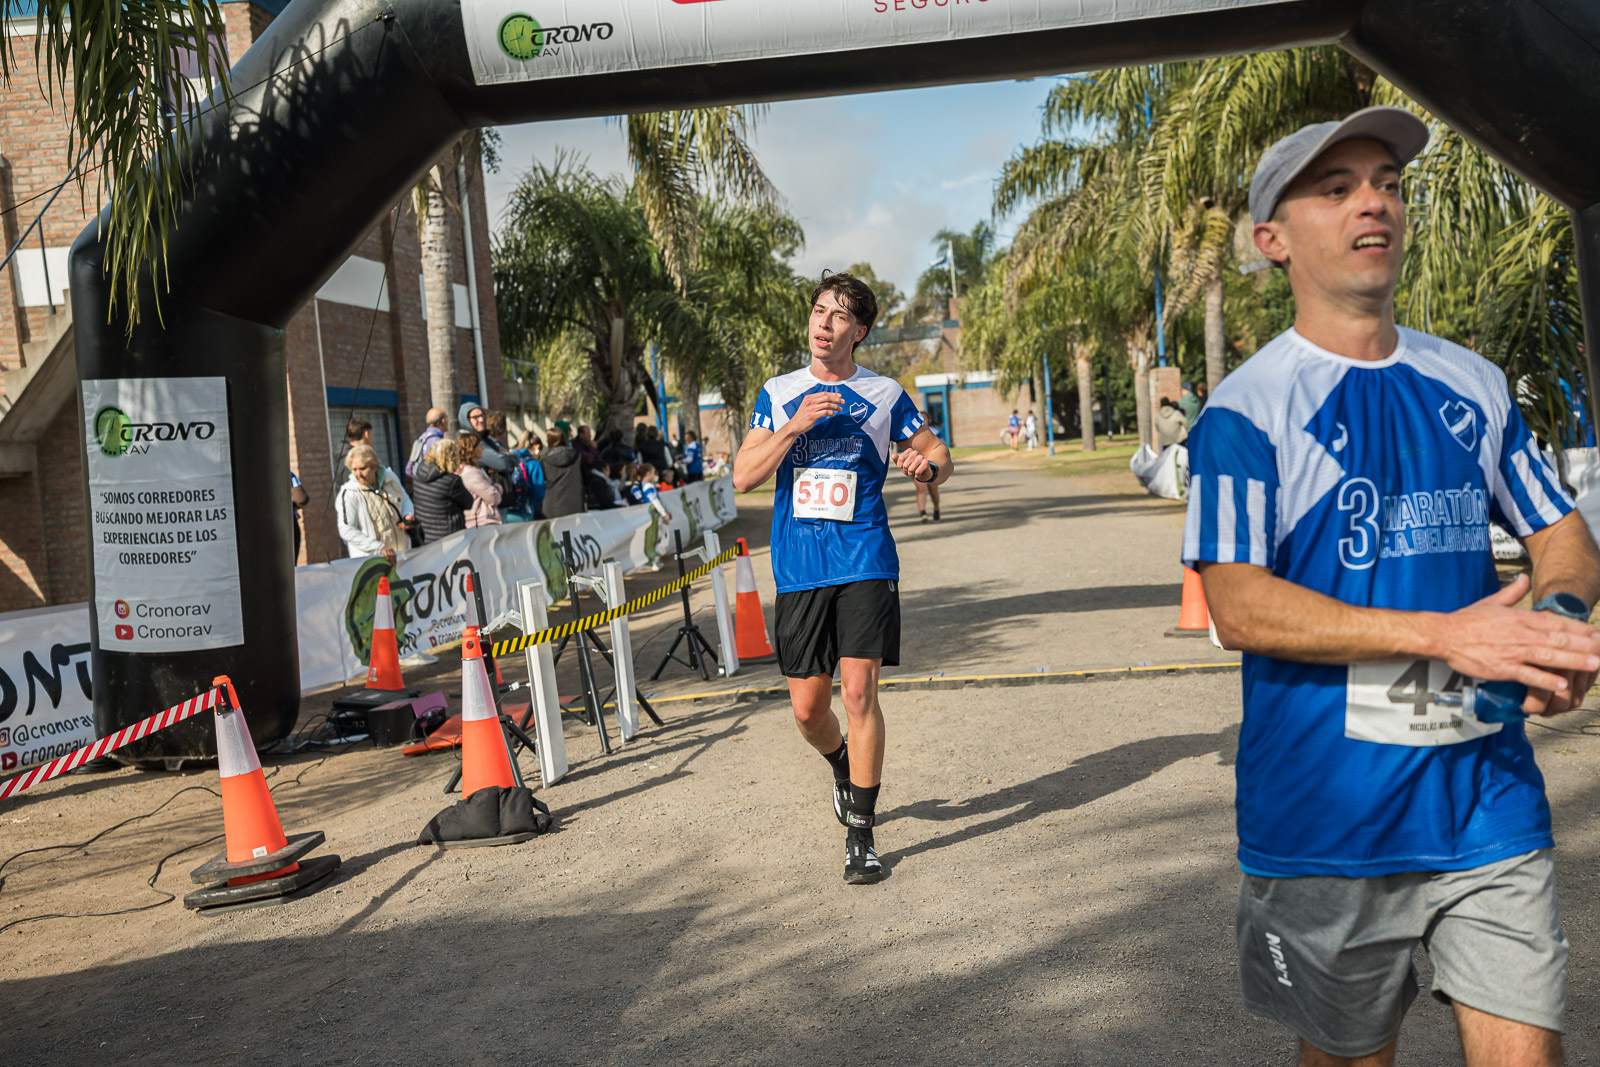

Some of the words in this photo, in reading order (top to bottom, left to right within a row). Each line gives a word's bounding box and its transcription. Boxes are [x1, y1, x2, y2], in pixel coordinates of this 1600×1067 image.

[874, 0, 989, 13] SEG
[531, 22, 613, 46] CRONO
[531, 47, 560, 58] RAV
[120, 421, 215, 442] CRONO
[120, 444, 150, 455] RAV
[792, 432, 808, 466] 3
[138, 489, 216, 504] CORREDORES
[797, 481, 849, 507] 510
[95, 510, 143, 525] BUSCANDO
[146, 509, 203, 524] MEJORAR
[205, 508, 227, 522] LAS
[1338, 477, 1380, 571] 3
[103, 531, 174, 545] EXPERIENCIAS
[177, 530, 193, 543] DE
[195, 529, 217, 542] LOS
[136, 603, 211, 618] Cronorav
[137, 624, 212, 639] Cronorav
[21, 737, 88, 766] cronorav
